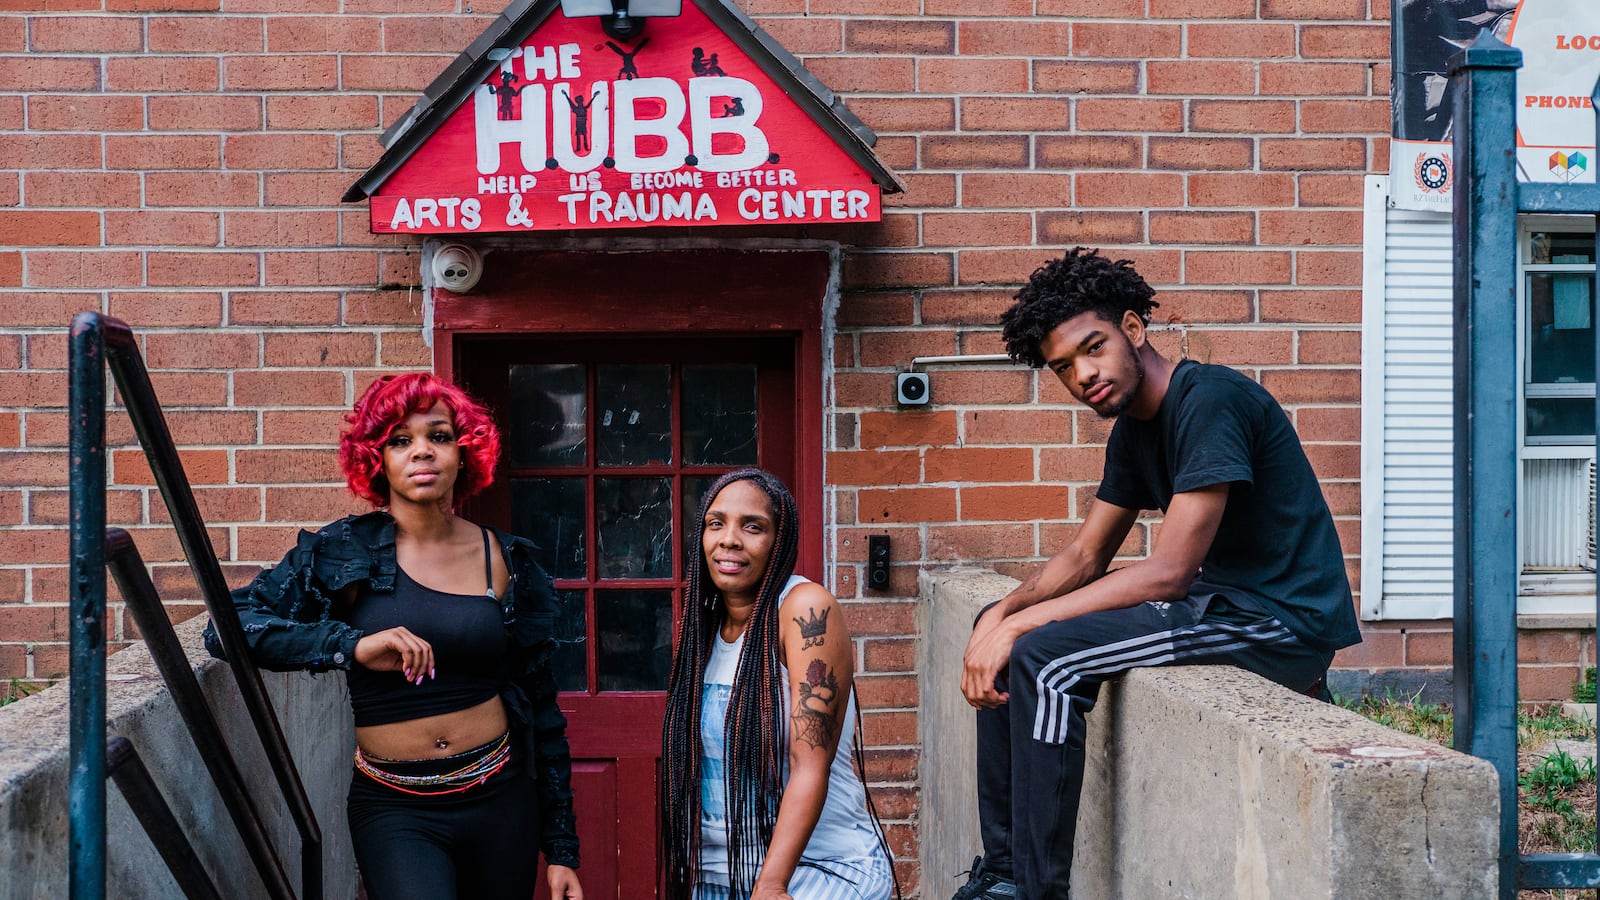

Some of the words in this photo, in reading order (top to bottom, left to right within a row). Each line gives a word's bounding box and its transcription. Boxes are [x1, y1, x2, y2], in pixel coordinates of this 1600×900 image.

[1556, 34, 1600, 50] LOC
[488, 43, 581, 81] THE
[1525, 95, 1593, 109] PHONE
[477, 174, 538, 194] HELP
[570, 171, 602, 191] US
[630, 171, 703, 190] BECOME
[717, 169, 798, 187] BETTER
[391, 197, 482, 230] ARTS
[506, 193, 534, 228] &
[557, 190, 718, 225] TRAUMA
[738, 187, 871, 220] CENTER
